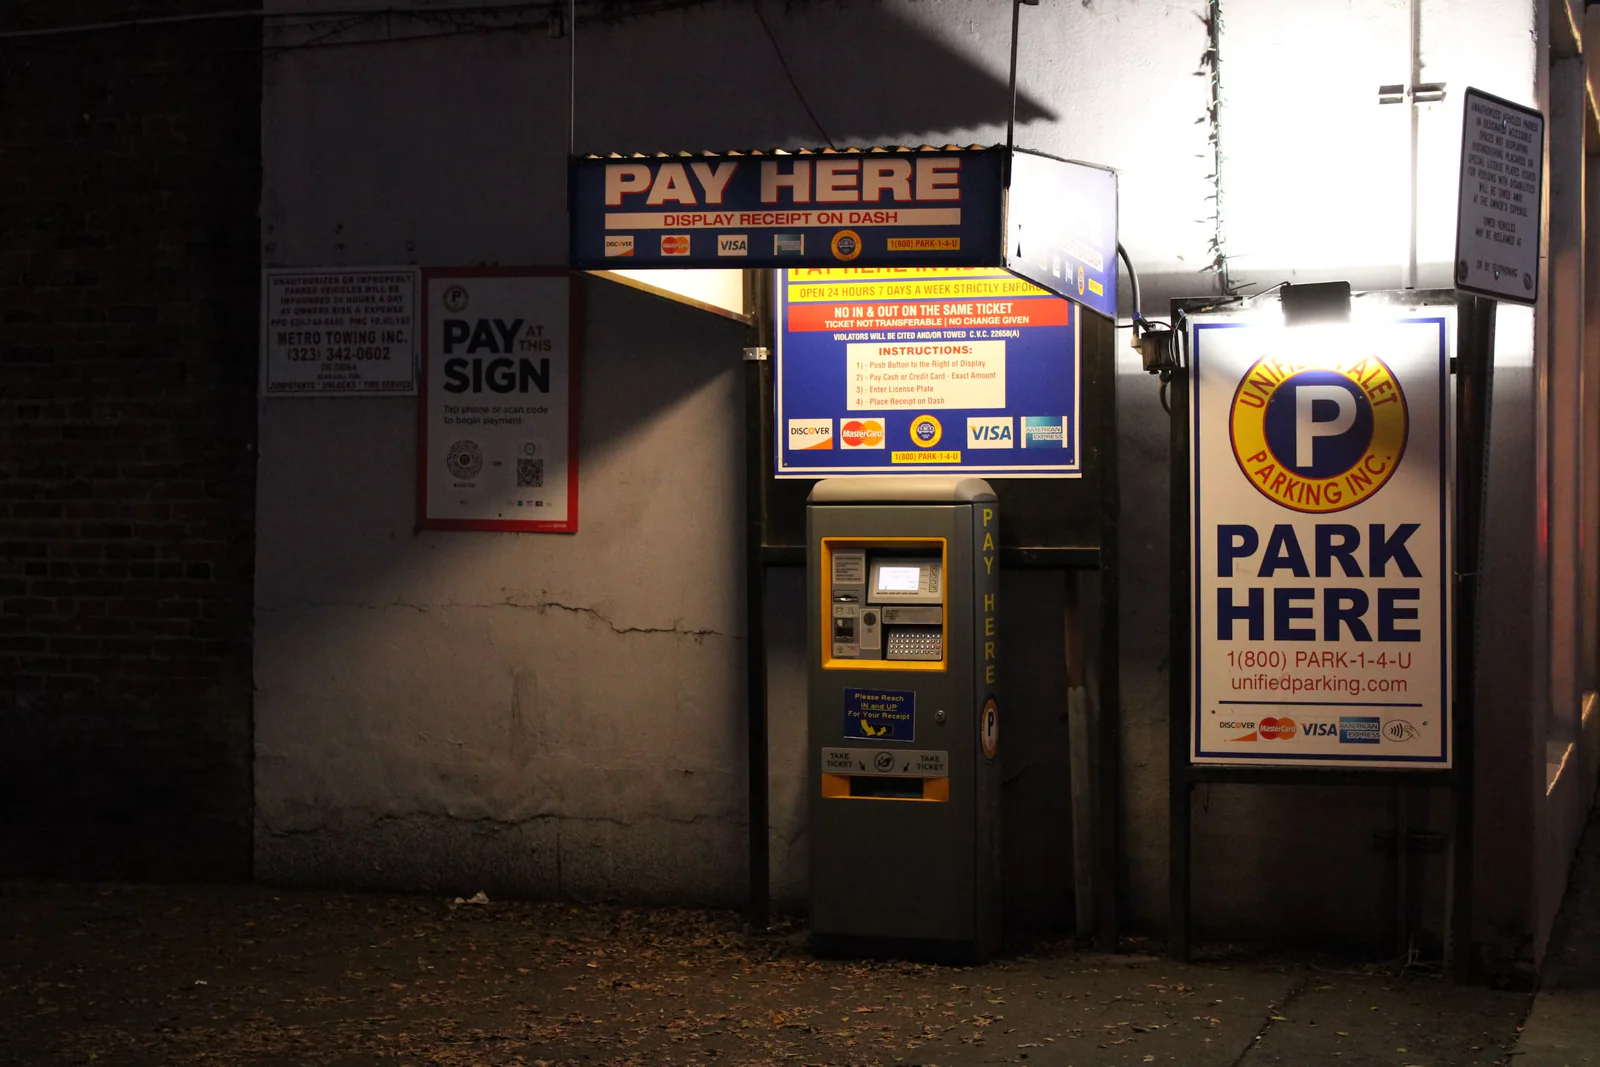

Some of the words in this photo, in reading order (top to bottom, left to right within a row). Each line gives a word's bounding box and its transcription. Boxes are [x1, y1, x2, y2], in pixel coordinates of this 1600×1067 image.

[605, 162, 738, 206] PAY
[761, 157, 962, 204] HERE
[664, 214, 734, 226] DISPLAY
[740, 212, 812, 225] RECEIPT
[817, 212, 843, 225] ON
[849, 211, 898, 224] DASH
[606, 240, 632, 248] DISCOVER
[720, 240, 747, 250] VISA
[890, 239, 914, 248] 1(800)
[915, 239, 957, 248] PARK-1-4-U
[800, 288, 825, 298] OPEN
[828, 288, 839, 297] 24
[842, 286, 875, 297] HOURS
[878, 286, 884, 296] 7
[887, 286, 912, 296] DAYS
[914, 285, 921, 295] A
[924, 284, 951, 294] WEEK
[954, 283, 1000, 293] STRICTLY
[834, 307, 849, 318] NO
[853, 306, 863, 318] IN
[866, 306, 875, 317] &
[878, 306, 899, 317] OUT
[902, 305, 917, 316] ON
[919, 304, 940, 316] THE
[943, 303, 973, 315] SAME
[976, 302, 1013, 314] TICKET
[825, 320, 854, 328] TICKET
[856, 319, 873, 328] NOT
[875, 317, 942, 327] TRANSFERABLE
[949, 317, 961, 326] NO
[963, 316, 1000, 326] CHANGE
[1002, 315, 1029, 325] GIVEN
[278, 332, 321, 345] METRO
[326, 331, 376, 345] TOWING
[382, 331, 408, 344] INC.
[443, 319, 524, 354] PAY
[525, 325, 544, 337] AT
[834, 333, 869, 341] VIOLATORS
[870, 332, 886, 340] WILL
[887, 332, 896, 340] BE
[897, 332, 915, 340] CITED
[916, 331, 942, 340] AND/OR
[943, 330, 966, 339] TOWED
[969, 330, 989, 338] C.V.C.
[518, 340, 552, 352] THIS
[878, 346, 973, 356] INSTRUCTIONS:
[288, 348, 321, 362] (323)
[326, 347, 391, 361] 342-0602
[856, 361, 864, 370] 1)
[869, 361, 886, 369] Push
[919, 360, 930, 368] the
[932, 360, 950, 369] Right
[960, 359, 986, 368] Display
[443, 358, 550, 394] SIGN
[856, 373, 864, 382] 2)
[869, 373, 881, 382] Pay
[883, 373, 899, 381] Cash
[930, 372, 945, 380] Card
[971, 371, 996, 379] Amount
[1336, 357, 1398, 407] ALET
[856, 386, 864, 394] 3)
[869, 386, 887, 394] Enter
[888, 385, 915, 393] License
[856, 398, 864, 406] 4)
[890, 397, 916, 406] Receipt
[928, 397, 945, 405] Dash
[445, 405, 459, 415] Tap
[462, 405, 490, 415] phone
[492, 406, 501, 414] or
[504, 406, 524, 414] scan
[526, 405, 549, 414] code
[444, 417, 453, 425] to
[456, 416, 481, 426] begin
[1296, 385, 1357, 468] P
[791, 427, 830, 436] DISCOVER
[842, 430, 883, 438] MasterCard
[969, 425, 1012, 440] VISA
[895, 453, 917, 461] 1(800)
[918, 452, 958, 461] PARK-1-4-U
[1246, 450, 1342, 506] PARKING
[1345, 454, 1392, 496] INC.
[983, 508, 994, 575] PAY
[1217, 523, 1423, 578] PARK
[1217, 587, 1421, 642] HERE
[984, 594, 995, 685] HERE
[1227, 650, 1287, 671] 1(800)
[1295, 651, 1411, 669] PARK-1-4-U
[1231, 674, 1408, 696] unifiedparking.com
[855, 693, 879, 701] Please
[881, 694, 904, 702] Reach
[886, 703, 898, 711] UP
[863, 711, 880, 719] Your
[882, 712, 910, 720] Receipt
[987, 711, 995, 737] P
[1220, 721, 1255, 729] DISCOVER
[1260, 725, 1296, 733] MasterCard
[1301, 723, 1338, 736] VISA
[1347, 731, 1380, 739] EXPRESS
[826, 760, 853, 768] TICKET
[916, 763, 944, 771] TICKET
